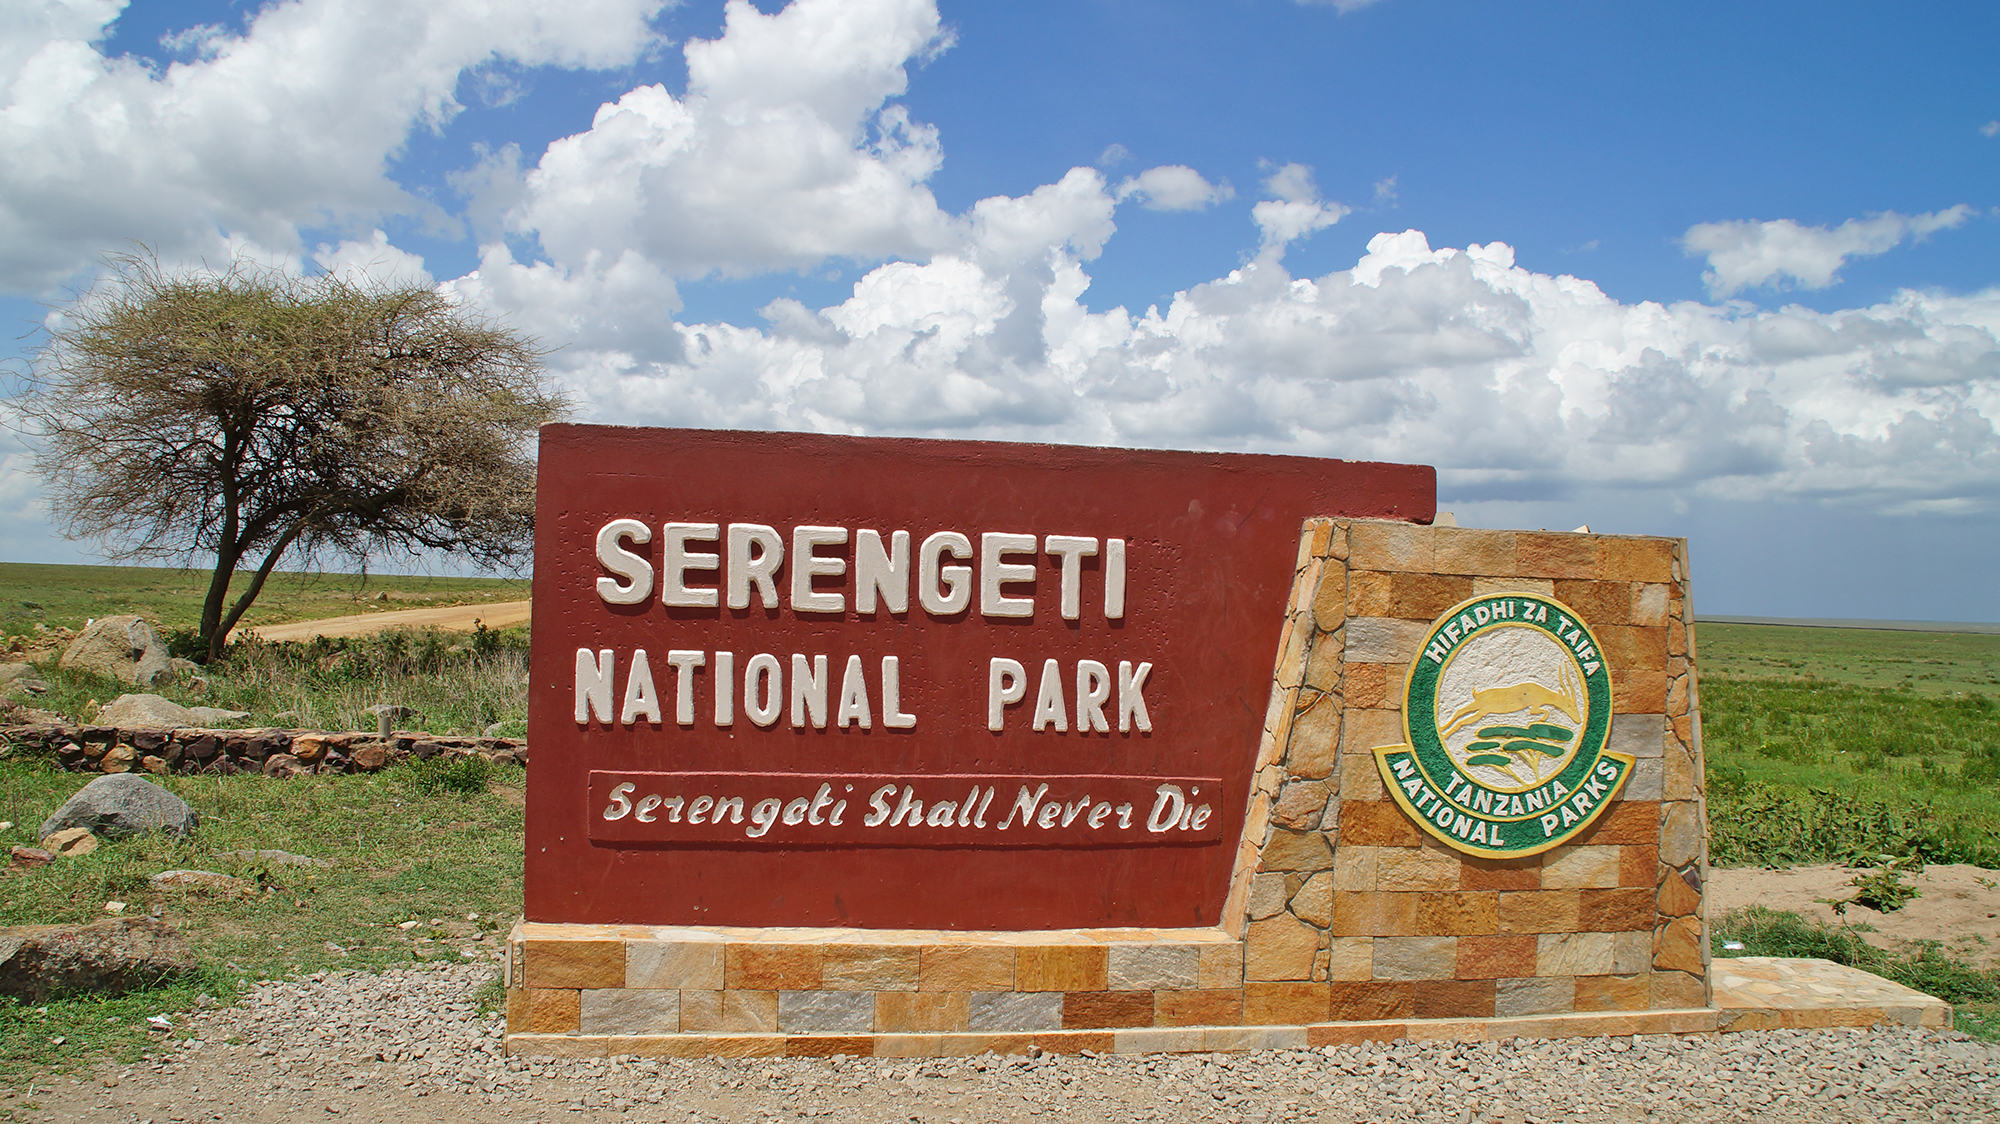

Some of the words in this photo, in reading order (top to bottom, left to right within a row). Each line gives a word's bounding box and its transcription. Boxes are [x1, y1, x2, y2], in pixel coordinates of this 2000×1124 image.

[596, 518, 1126, 620] SERENGETI
[1425, 601, 1515, 665] HIFADHI
[1523, 602, 1548, 624] ZA
[1556, 616, 1602, 677] TAIFA
[574, 647, 917, 729] NATIONAL
[987, 656, 1153, 733] PARK
[602, 781, 854, 838] Serengeti
[863, 783, 995, 828] Shall
[997, 782, 1133, 831] Never
[1146, 782, 1212, 834] Die
[1393, 758, 1505, 846] NATIONAL
[1540, 761, 1619, 837] PARKS
[1444, 771, 1569, 817] TANZANIA
